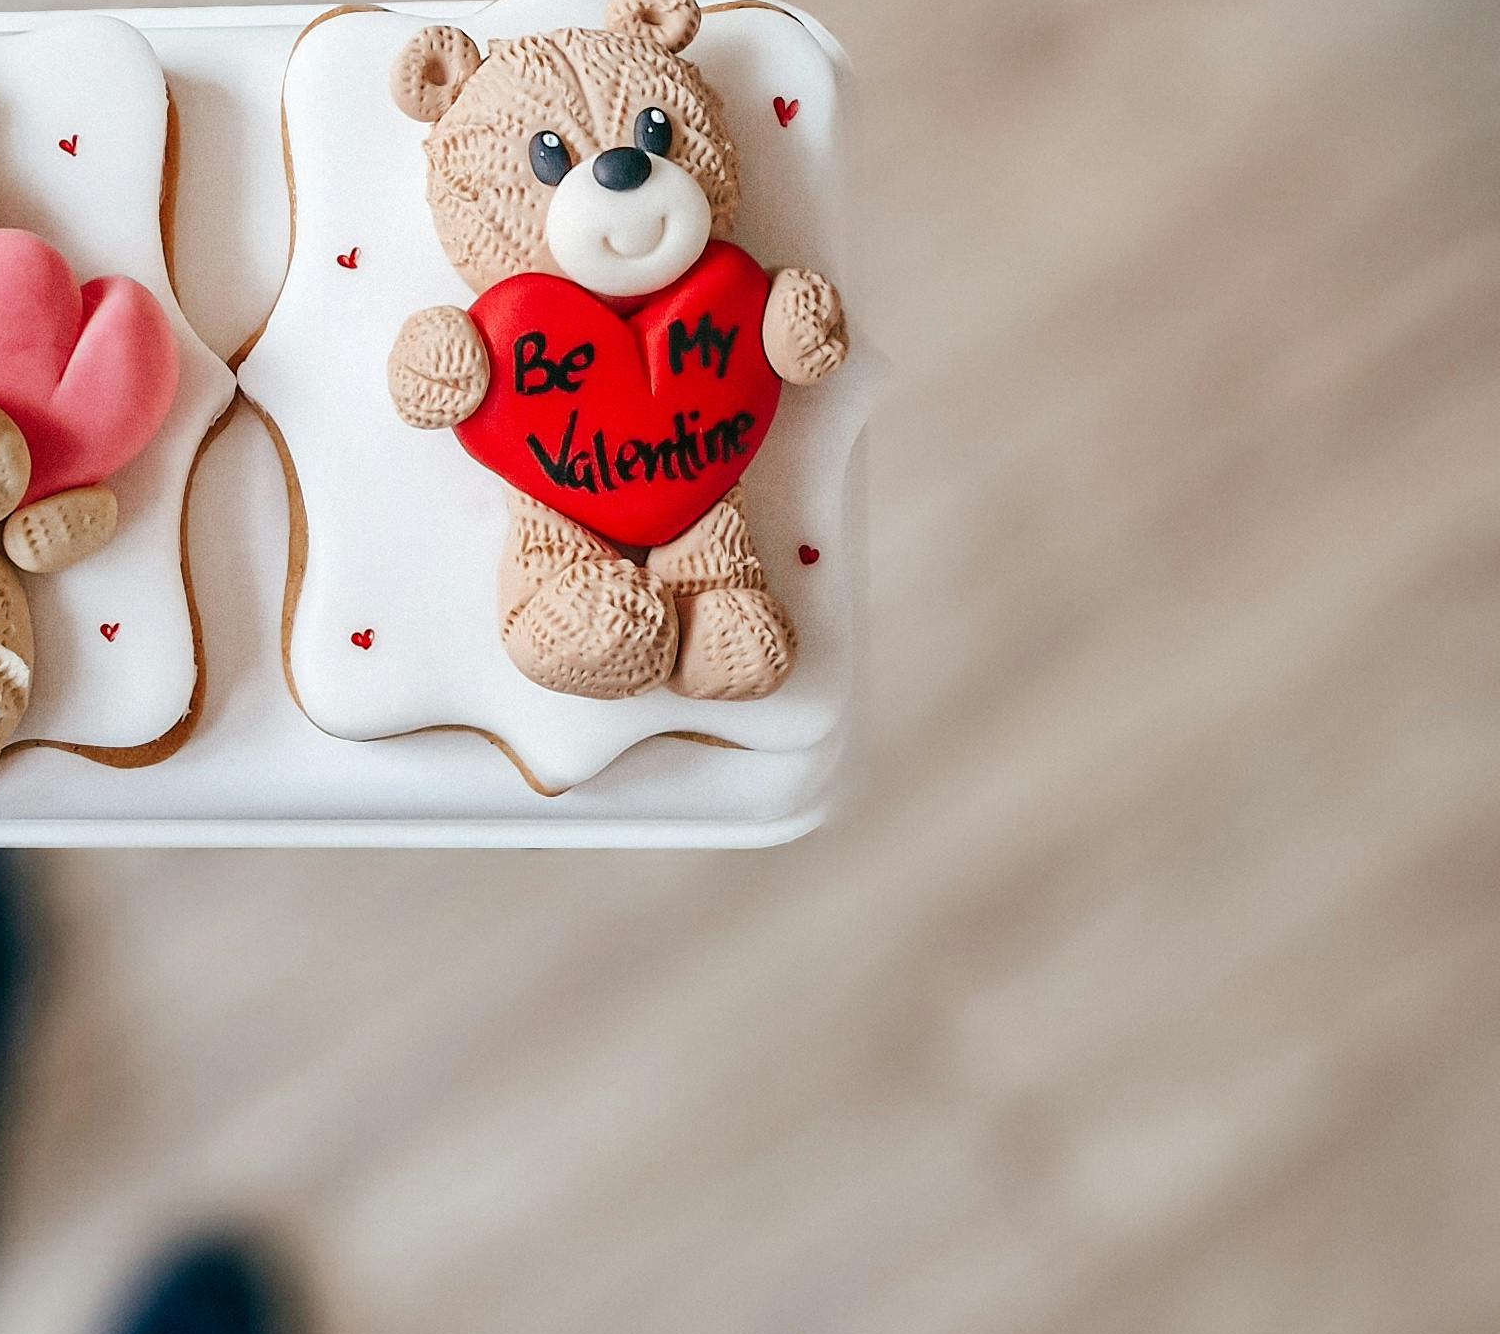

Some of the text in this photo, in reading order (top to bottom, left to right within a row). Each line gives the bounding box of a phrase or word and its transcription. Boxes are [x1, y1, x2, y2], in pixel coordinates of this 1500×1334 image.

[514, 312, 740, 396] Be My
[526, 410, 757, 494] Valentine
